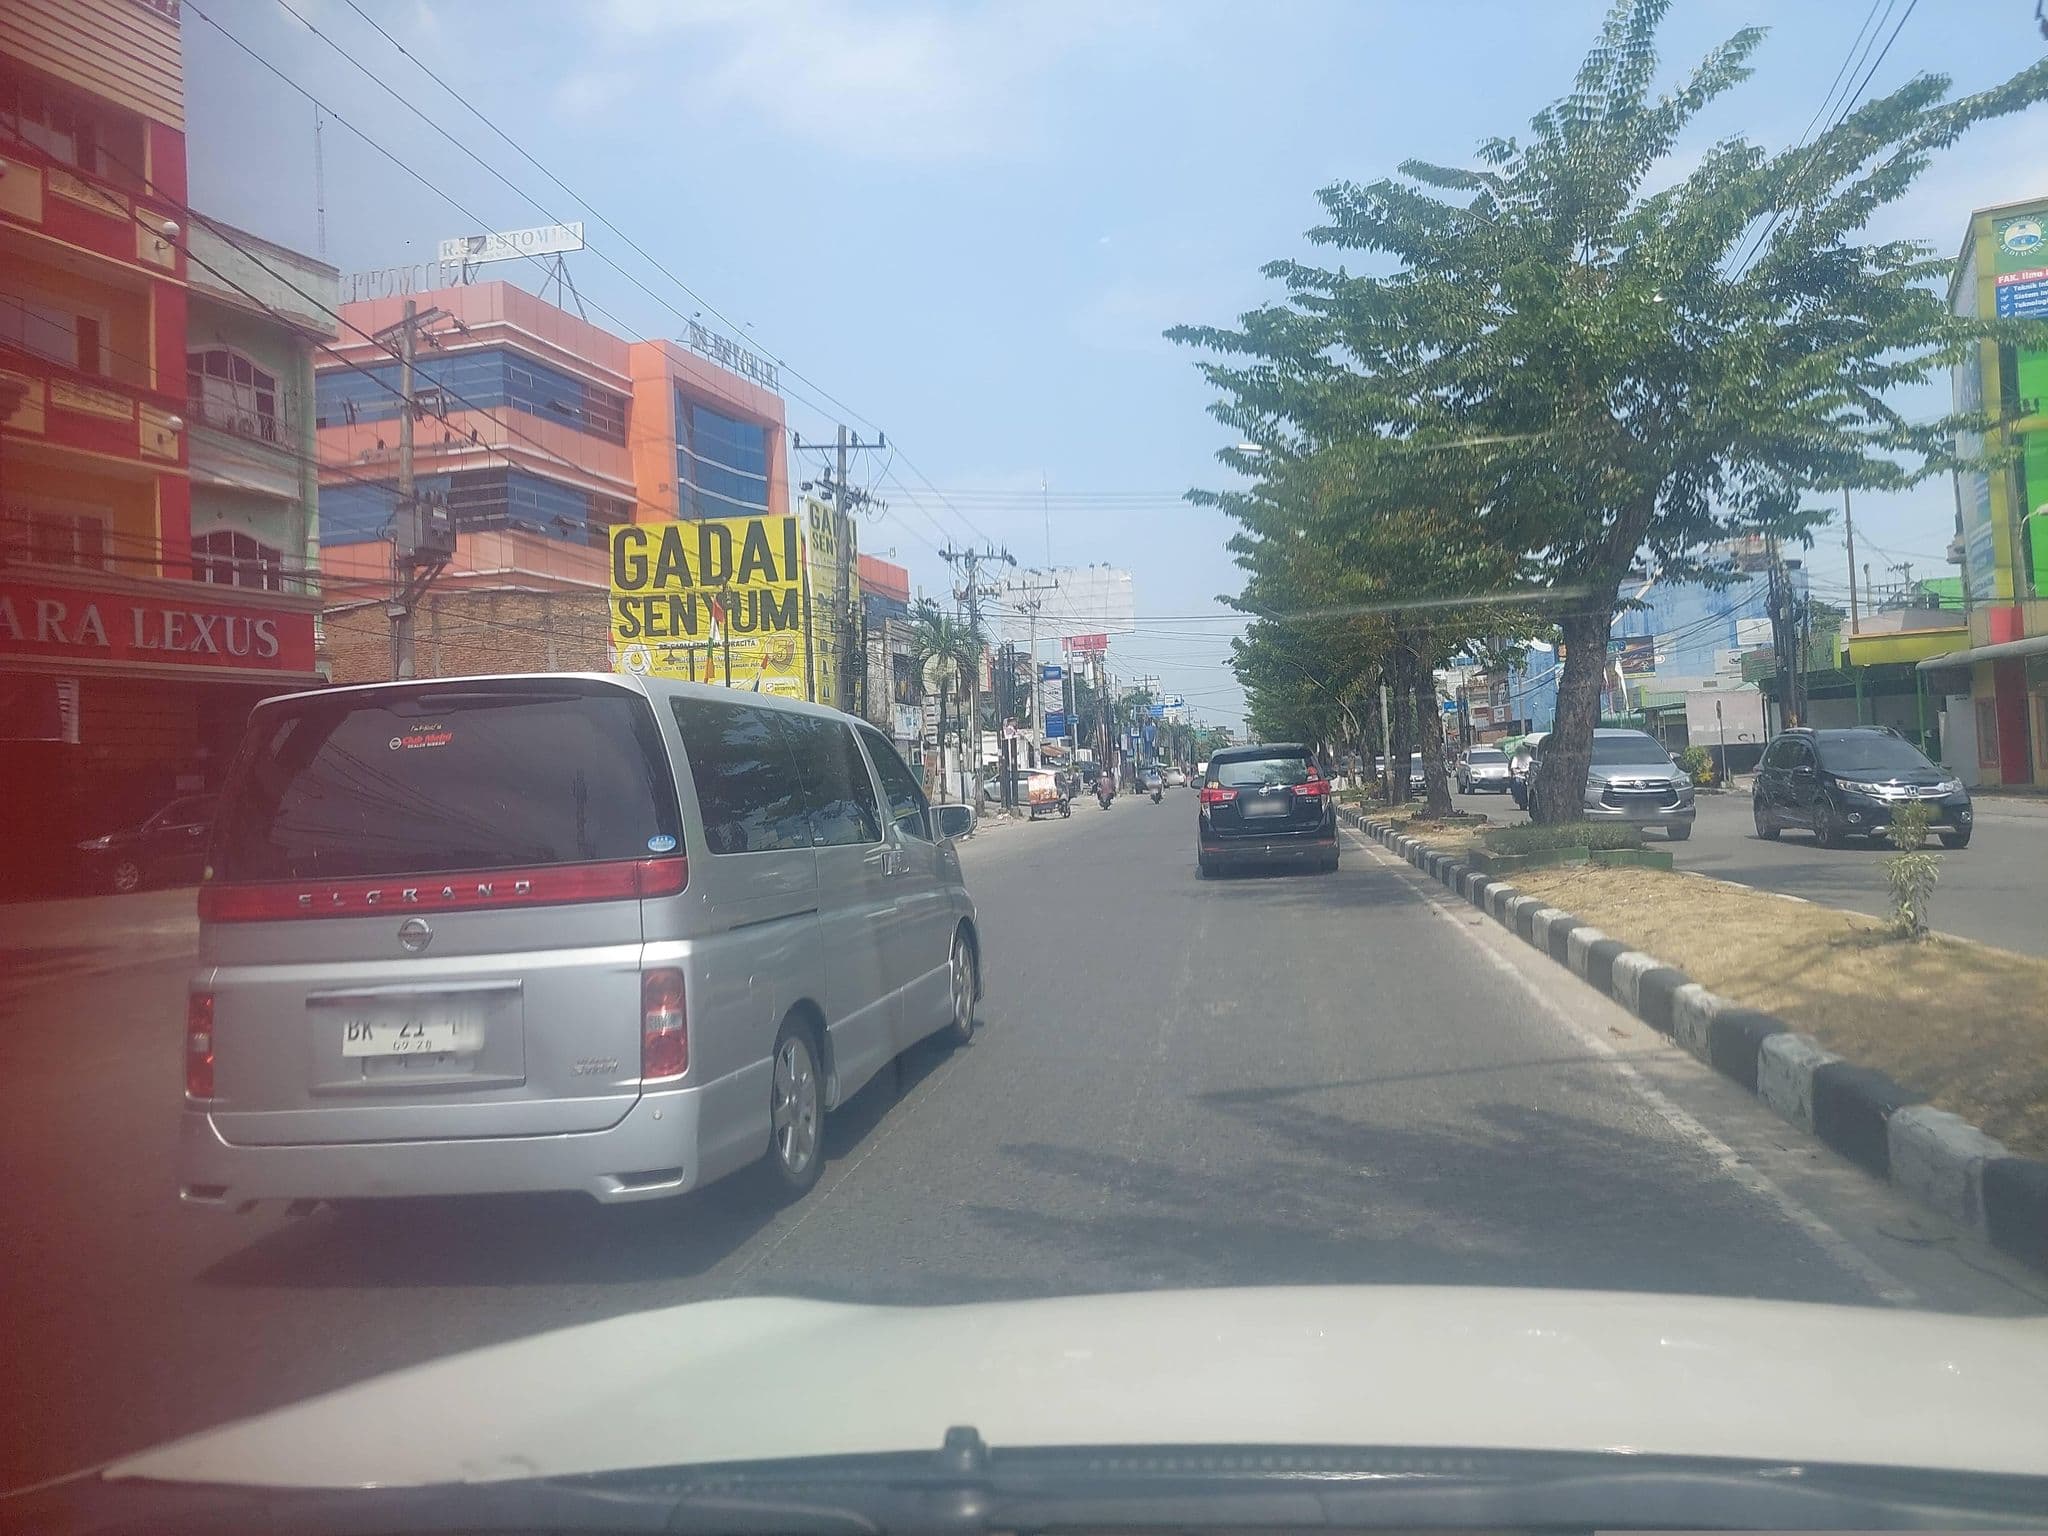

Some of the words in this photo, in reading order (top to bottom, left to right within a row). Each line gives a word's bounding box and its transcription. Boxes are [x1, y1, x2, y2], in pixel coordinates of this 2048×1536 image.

[612, 517, 797, 591] GADAI
[129, 607, 279, 658] LEXUS
[618, 587, 798, 638] SENYUM
[298, 880, 531, 907] ELGRAND
